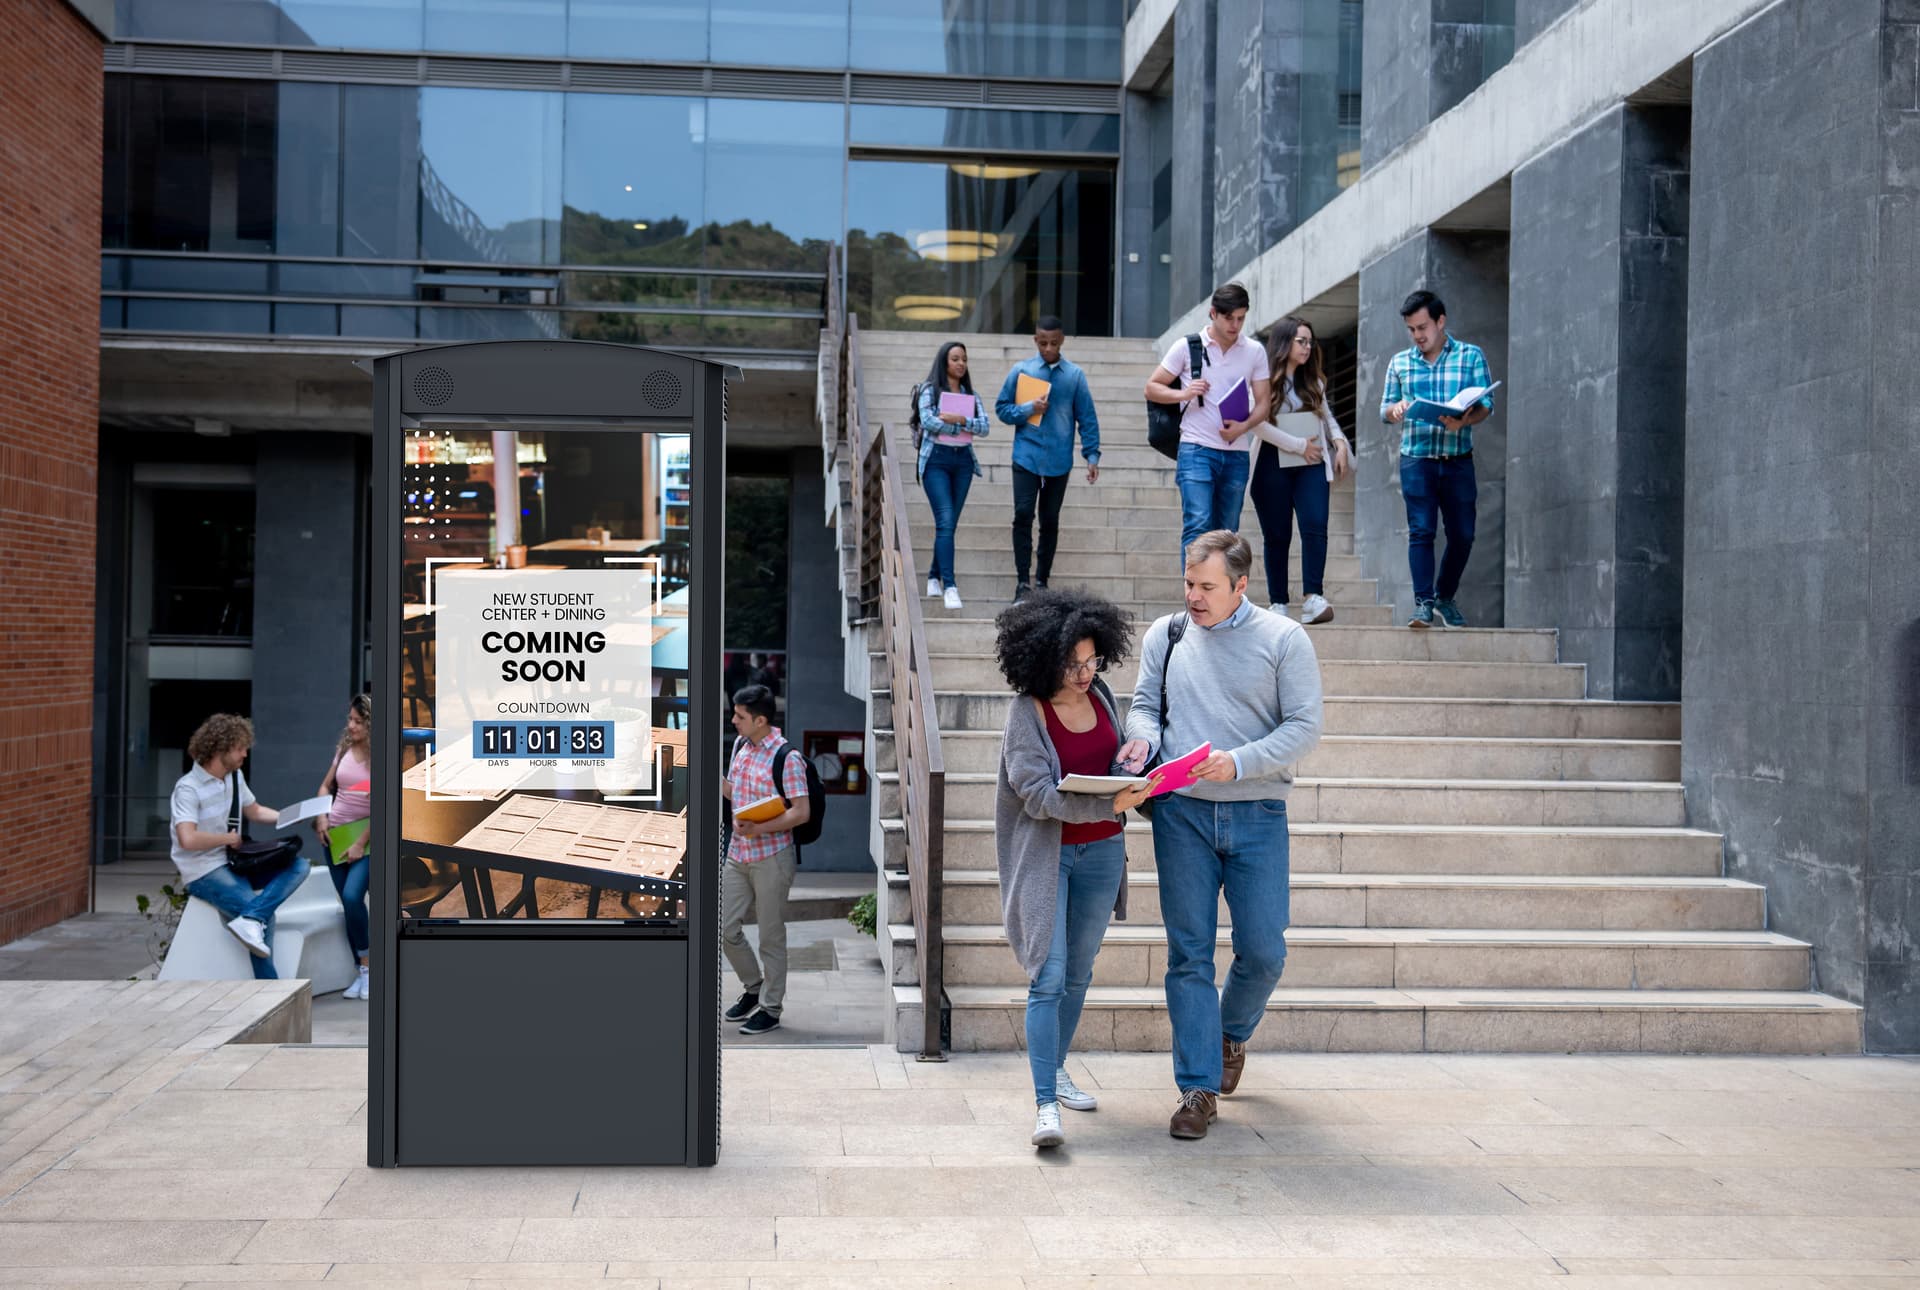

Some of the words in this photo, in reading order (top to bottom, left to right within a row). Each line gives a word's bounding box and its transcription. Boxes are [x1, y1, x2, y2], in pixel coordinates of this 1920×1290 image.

[493, 592, 527, 606] NEW
[530, 592, 595, 606] STUDENT
[481, 607, 537, 622] CENTER
[554, 607, 606, 622] DINING
[481, 631, 606, 654] COMING
[501, 659, 586, 683] SOON
[497, 702, 590, 714] COUNTDOWN
[488, 759, 509, 767] DAYS
[529, 759, 558, 767] HOURS
[571, 759, 606, 767] MINUTES
